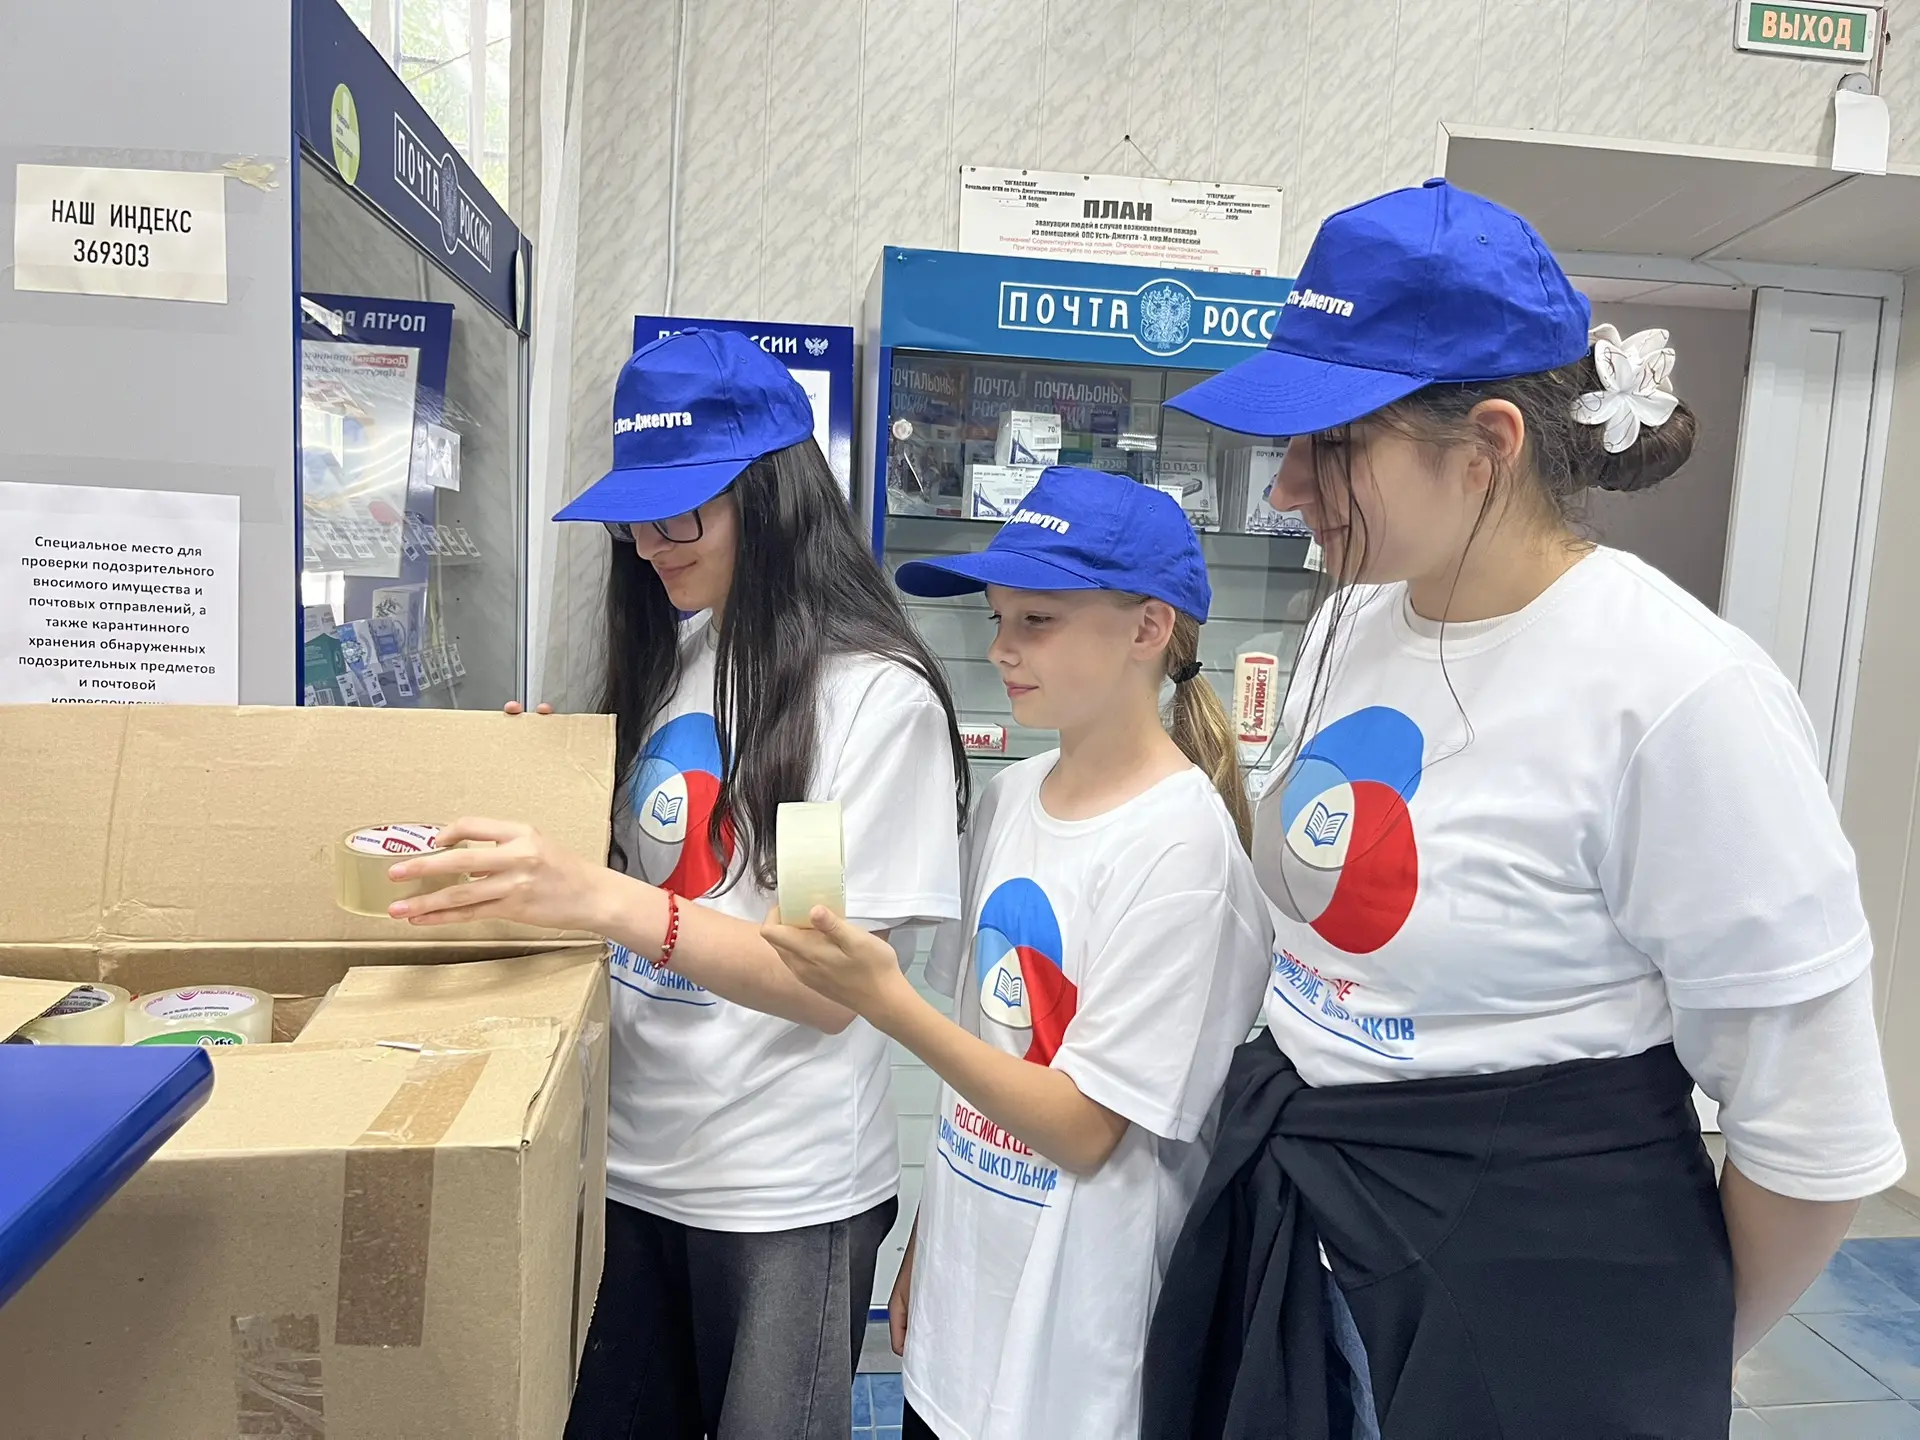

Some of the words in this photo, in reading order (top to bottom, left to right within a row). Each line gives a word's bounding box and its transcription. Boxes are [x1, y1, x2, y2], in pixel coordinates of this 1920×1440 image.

[1761, 10, 1852, 51] ВЫХОД
[397, 129, 440, 212] ПОЧТА
[459, 198, 491, 262] РОССИИ
[51, 199, 95, 226] НАШ
[110, 203, 192, 235] ИНДЕКС
[1083, 199, 1153, 221] ПЛАН
[1034, 219, 1070, 228] эвакуации
[1070, 220, 1094, 230] людей
[1099, 223, 1123, 232] случае
[1123, 224, 1173, 234] возникновения
[1173, 227, 1198, 236] пожара
[1040, 229, 1080, 238] помещений
[1081, 231, 1095, 239] ОПС
[73, 239, 150, 267] 369303
[1012, 243, 1025, 251] При
[1008, 290, 1129, 330] ПОЧТА
[1202, 305, 1277, 340] РОСС
[750, 335, 798, 355] ССИИ
[892, 366, 958, 396] ОЧТАЛЬОНЫ
[892, 391, 929, 413] ОССИИ
[34, 535, 128, 552] Специальное
[131, 543, 174, 556] место
[177, 546, 203, 557] для
[21, 555, 89, 571] проверки
[92, 559, 215, 577] подозрительного
[33, 576, 109, 591] вносимого
[112, 580, 191, 596] имущества
[194, 586, 203, 596] и
[28, 596, 96, 610] почтовых
[99, 599, 196, 616] отправлений,
[198, 606, 207, 616] а
[45, 617, 89, 630] также
[92, 619, 190, 635] карантинного
[28, 636, 96, 650] хранения
[99, 637, 207, 655] обнаруженных
[18, 655, 137, 671] подозрительных
[140, 661, 216, 675] предметов
[78, 678, 88, 688] и
[91, 679, 157, 691] почтовой
[1252, 667, 1268, 731] АКТИВИСТ
